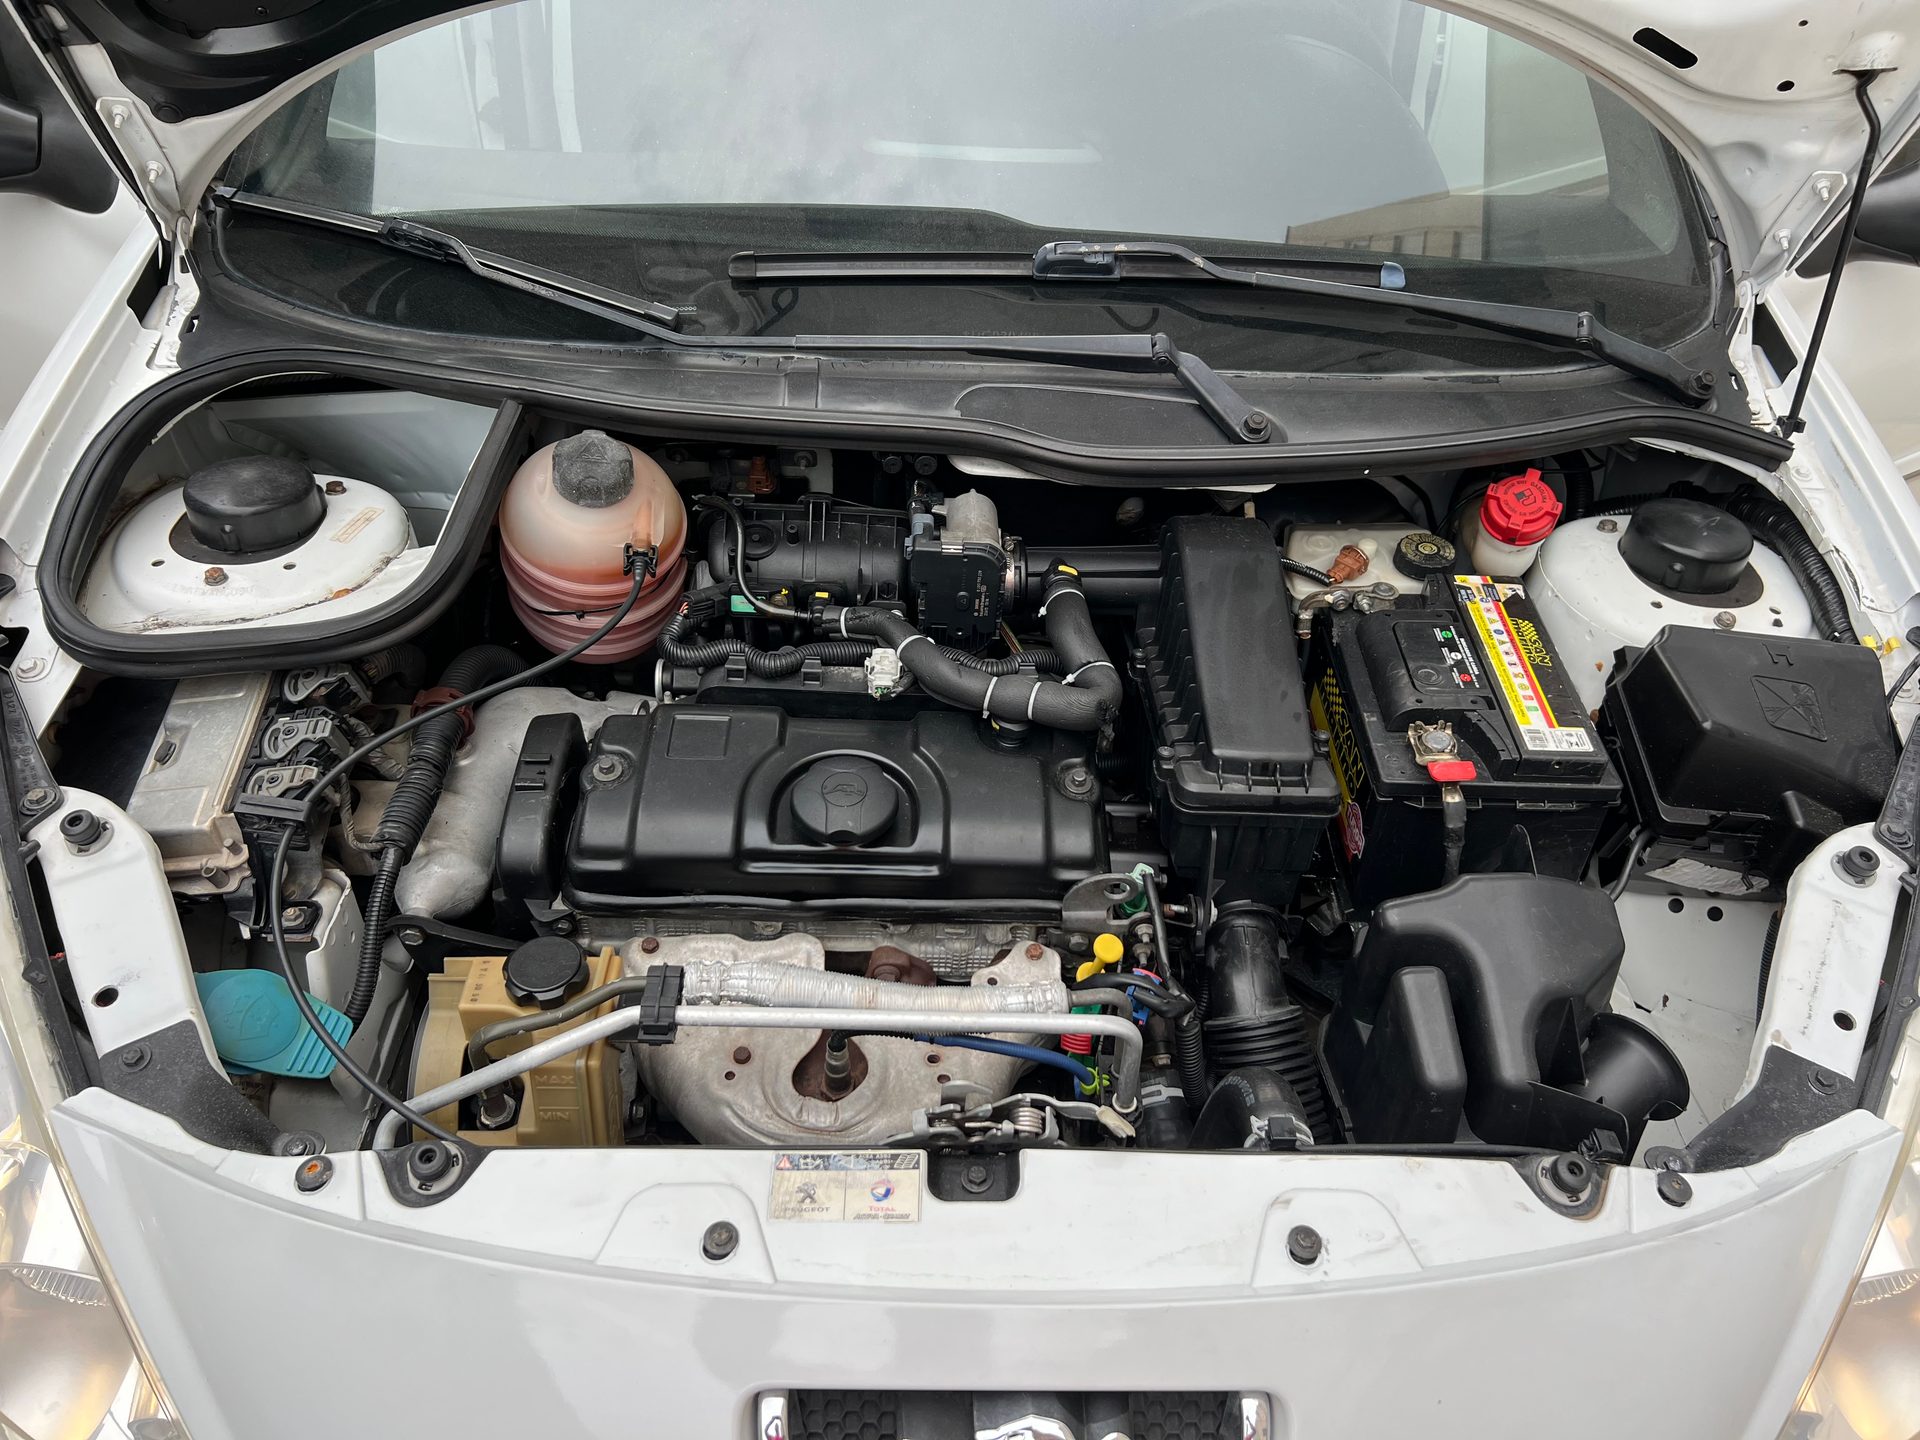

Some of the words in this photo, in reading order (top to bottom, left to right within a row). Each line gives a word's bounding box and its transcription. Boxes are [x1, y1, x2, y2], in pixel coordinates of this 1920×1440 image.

[1509, 617, 1538, 664] marino
[1529, 638, 1552, 666] SAN
[1336, 708, 1365, 788] SAN
[535, 1075, 574, 1084] MAX
[539, 1112, 569, 1120] MIN
